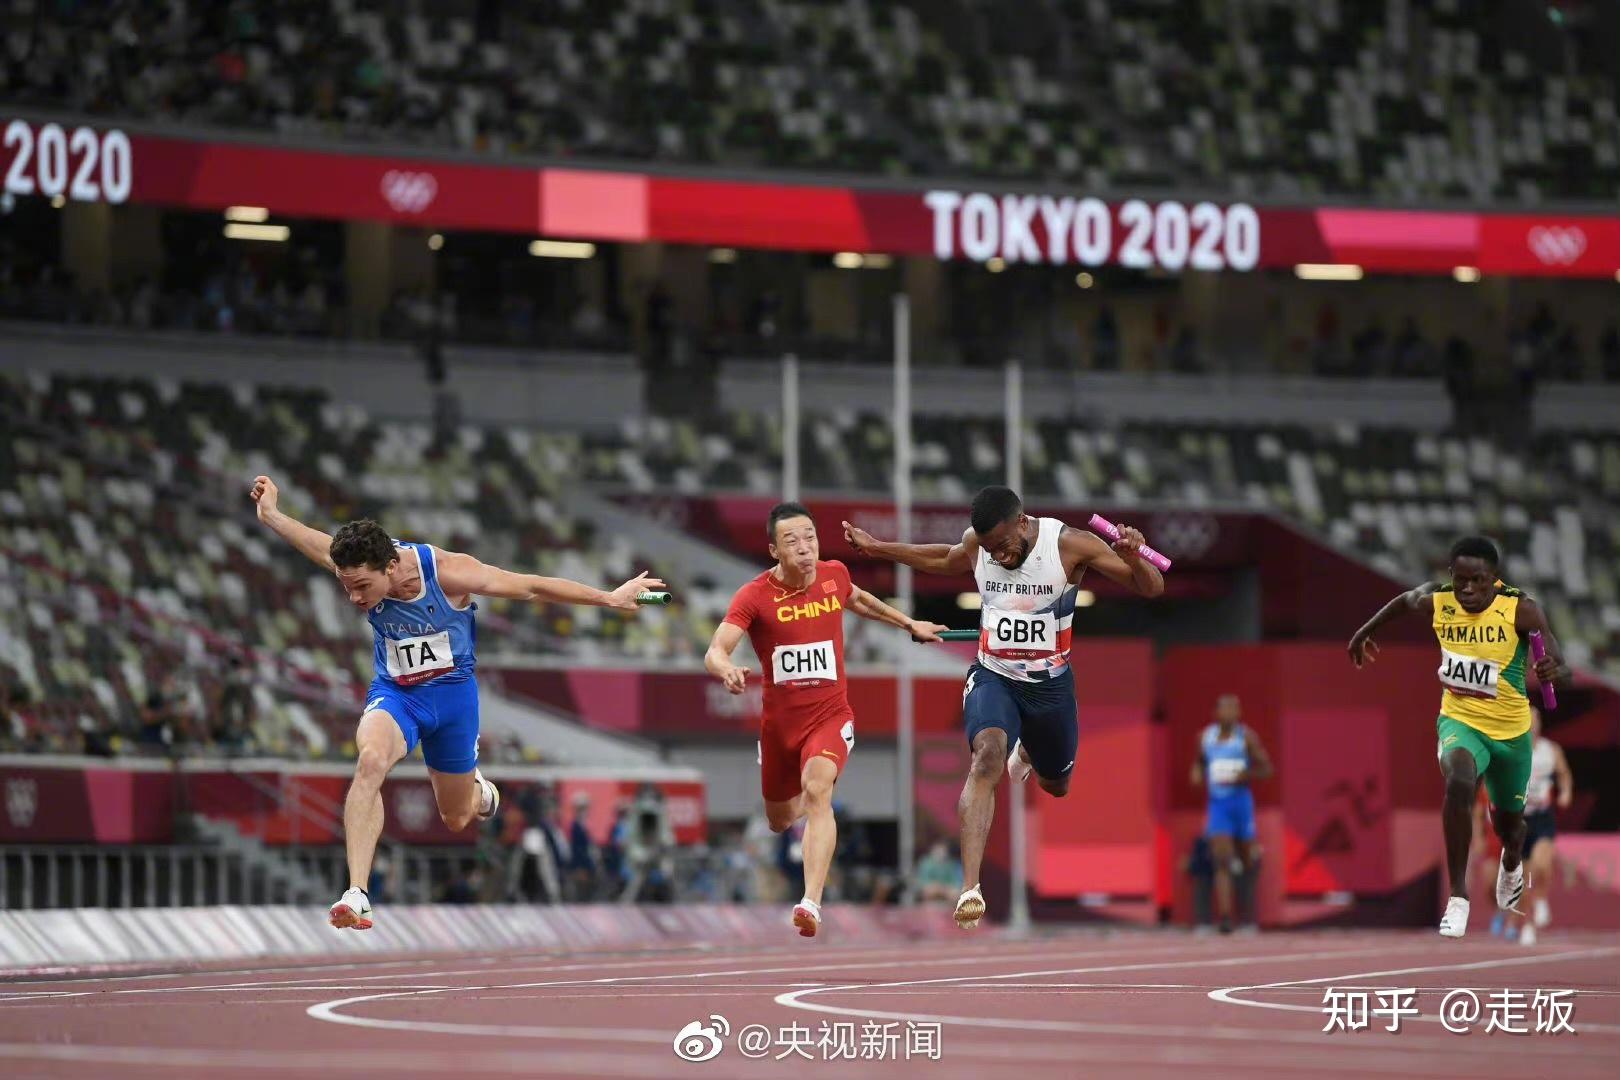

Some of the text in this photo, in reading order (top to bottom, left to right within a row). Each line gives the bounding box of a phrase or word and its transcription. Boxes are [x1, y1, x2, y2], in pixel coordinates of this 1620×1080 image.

[3, 120, 133, 204] 2020
[924, 189, 1260, 271] TOKYO 2020
[985, 580, 1053, 595] GREAT BRITAIN
[776, 593, 842, 623] CHINA
[383, 621, 436, 635] ITALIA
[996, 617, 1046, 643] GBR
[1440, 622, 1507, 643] JAMAICA
[395, 641, 437, 668] ITA
[780, 647, 828, 673] CHN
[1442, 657, 1491, 686] JAM
